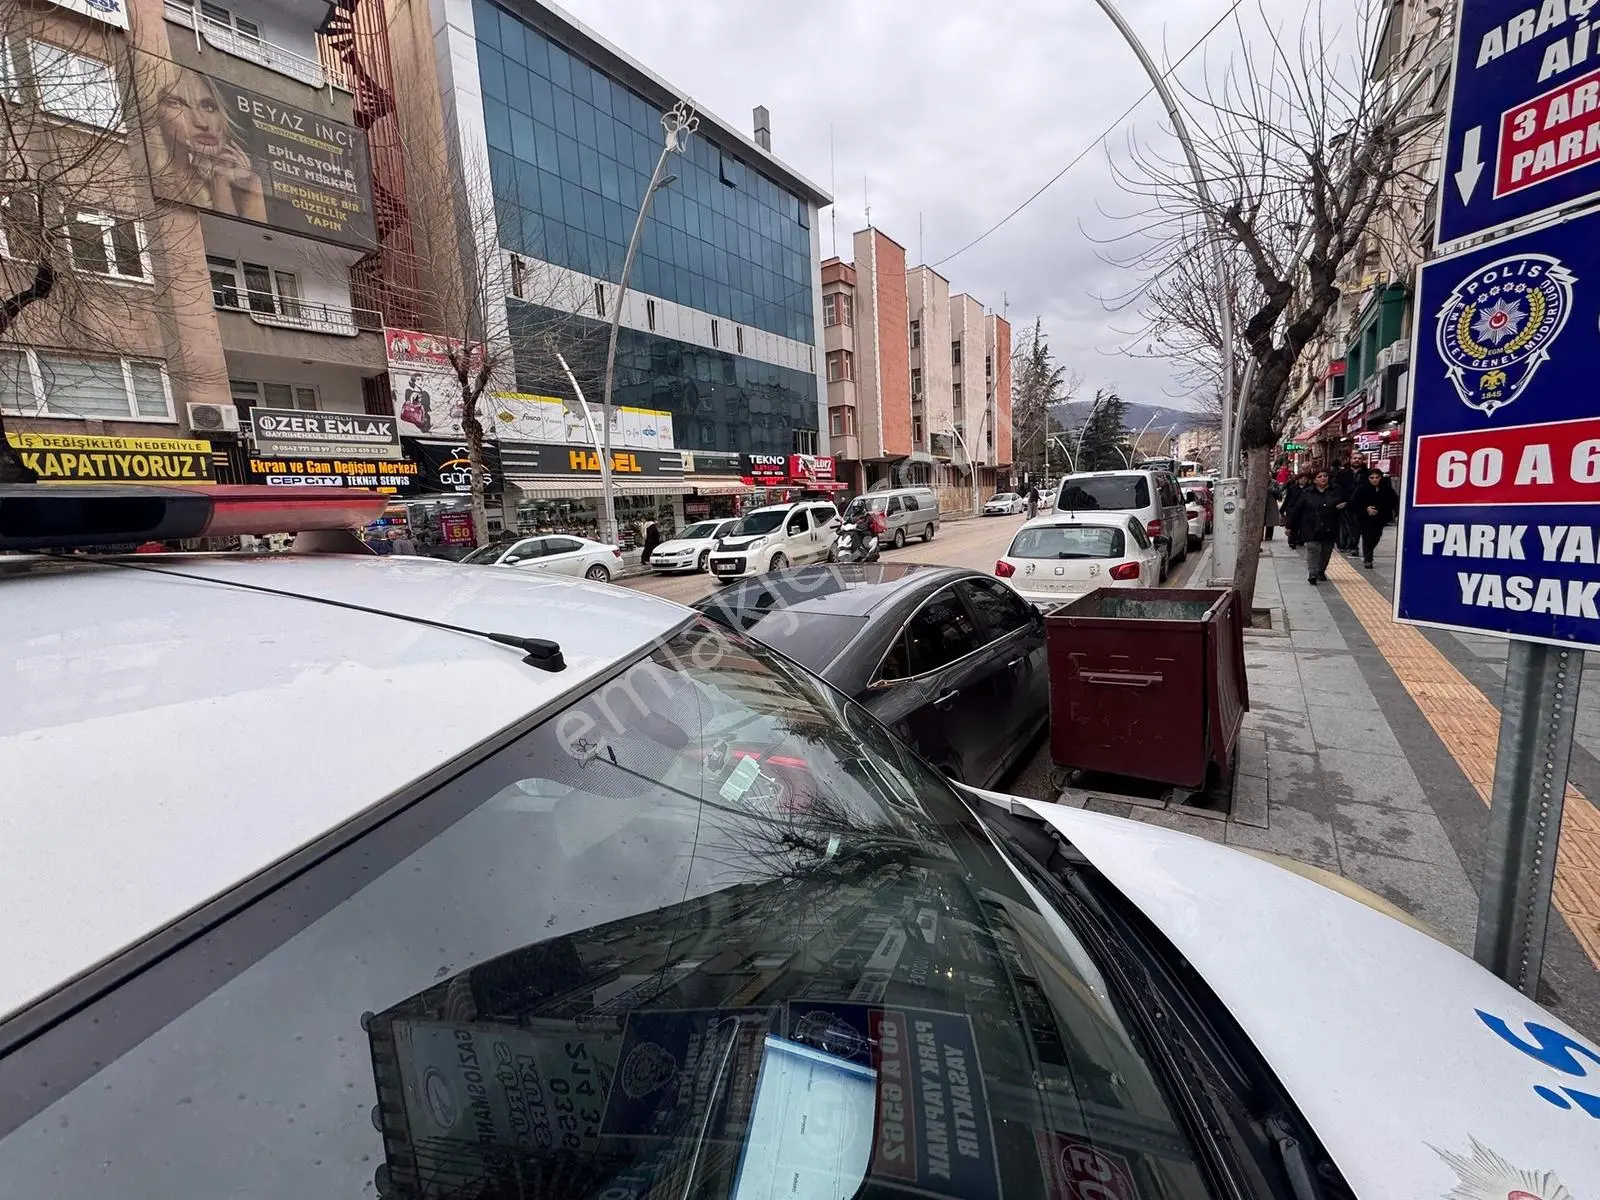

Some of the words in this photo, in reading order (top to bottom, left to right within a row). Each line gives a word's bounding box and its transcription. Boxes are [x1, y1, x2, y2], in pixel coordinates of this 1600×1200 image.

[237, 95, 305, 132] BEYAZ
[1513, 108, 1537, 142] 3
[1543, 80, 1600, 130] AR
[267, 144, 341, 175] EPİLASYON
[272, 160, 300, 177] CİLT
[304, 168, 358, 193] MERKEZİ
[273, 181, 338, 206] KENDİNİZE
[291, 199, 347, 221] GÜZELLİK
[304, 214, 342, 232] YAPIN
[1467, 260, 1543, 295] POLİS
[1472, 353, 1519, 368] GENEL
[1480, 390, 1502, 400] 1845
[324, 420, 391, 436] EMLAK
[19, 437, 33, 447] İŞ
[43, 438, 128, 449] DEĞİŞİKLİĞİ
[136, 441, 202, 451] NEDENİYLE
[21, 452, 196, 477] KAPATIYORUZ
[250, 459, 286, 473] Ekran
[291, 462, 303, 473] ve
[307, 460, 331, 474] Cam
[334, 461, 375, 476] Değişim
[379, 462, 418, 475] Merkezi
[569, 450, 642, 473] HAEL
[748, 454, 785, 466] TEKNO
[1436, 447, 1503, 488] 60
[1514, 444, 1554, 485] A
[271, 477, 301, 485] CEP
[1422, 523, 1528, 560] PARK
[1538, 525, 1600, 564] YA
[1457, 572, 1600, 619] YASAK
